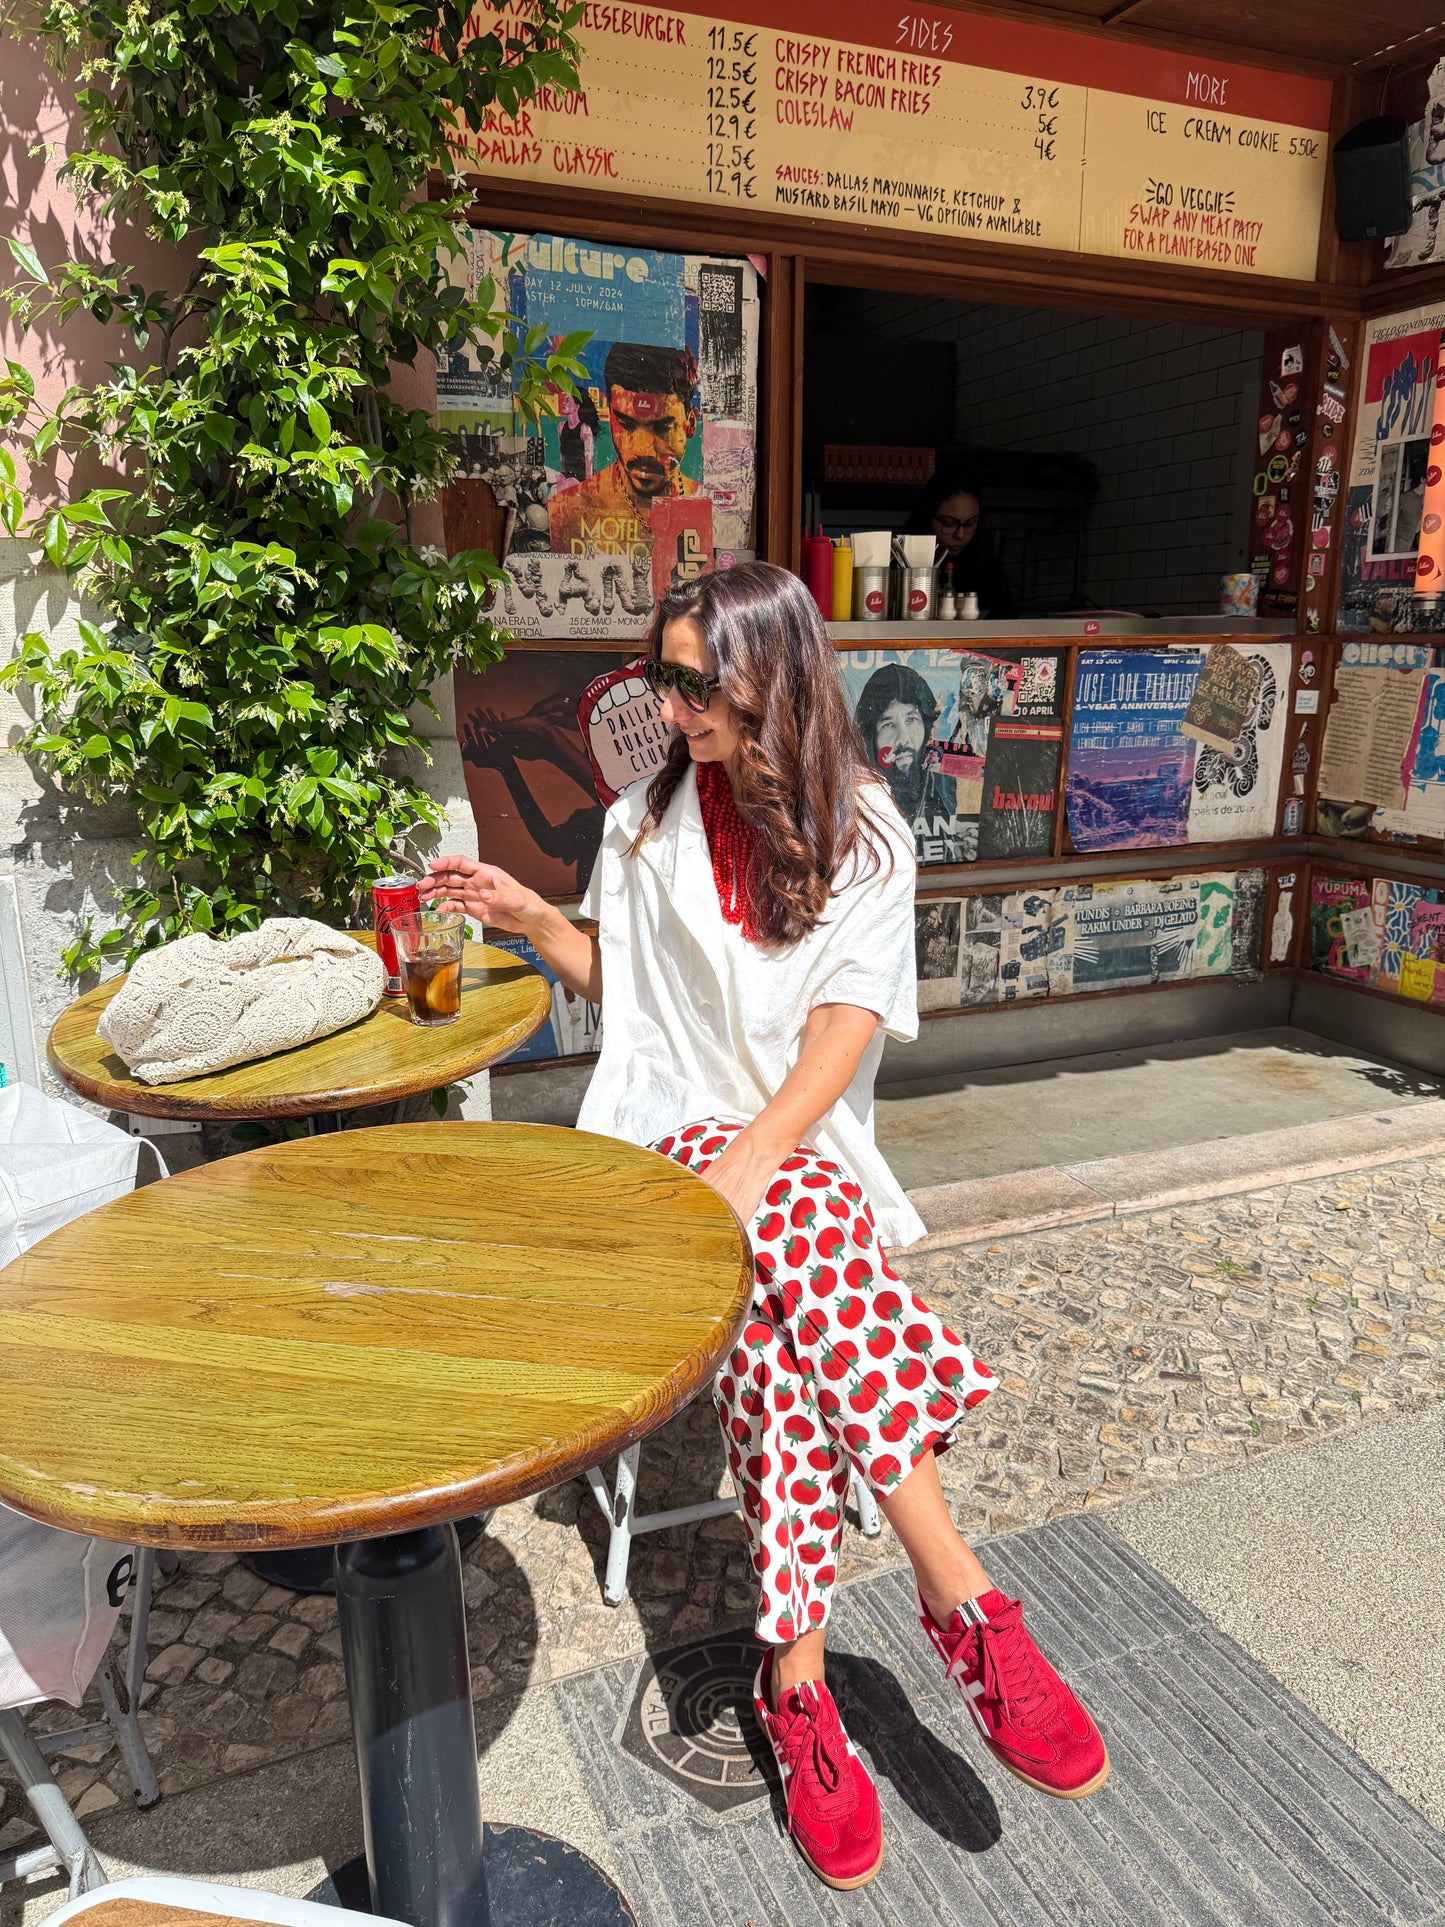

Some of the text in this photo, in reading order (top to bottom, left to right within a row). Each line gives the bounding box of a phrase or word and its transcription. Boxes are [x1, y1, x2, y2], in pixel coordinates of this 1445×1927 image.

[564, 1, 687, 46] EESEBURGER
[895, 15, 954, 53] SIDES
[706, 56, 758, 86] 12.5€
[775, 38, 942, 88] CRISPY FRENCH FRIES
[706, 86, 757, 115] 12.5€
[775, 67, 931, 116] CRISPY BACON FRIES
[1020, 86, 1060, 111] 3.9€
[1184, 71, 1230, 106] MORE
[465, 107, 534, 139] RGER
[775, 98, 854, 133] COLESLAW
[1038, 114, 1058, 136] 5€
[1146, 109, 1168, 134] ICE
[1183, 117, 1232, 146] CREAM
[1238, 129, 1279, 153] COOKIE
[476, 136, 543, 166] DALLAS
[552, 145, 619, 179] CLASSIC
[706, 142, 757, 172] 12.5€
[1034, 137, 1057, 161] 4€
[775, 164, 825, 186] SAUCES:
[952, 190, 1006, 212] KETCHUP
[1155, 182, 1224, 214] GO VEGGIE
[833, 192, 868, 214] BASIL
[870, 199, 900, 219] MAYO
[917, 204, 934, 223] VG
[937, 206, 983, 230] OPTIONS
[985, 212, 1042, 238] AVAILABLE
[1129, 203, 1263, 242] SWAP ANY MEAT PATTY
[1122, 228, 1144, 250] FOR
[1146, 234, 1156, 252] A
[1234, 246, 1256, 268] ONE
[549, 280, 563, 292] 12
[598, 286, 624, 300] 2024
[575, 297, 625, 313] 10PM/6AM
[579, 516, 641, 542] MOTEL
[508, 616, 527, 627] ERA
[1075, 673, 1105, 703] JUST
[1110, 673, 1140, 703] LOOK
[606, 697, 662, 736] DALLAS
[1029, 705, 1055, 717] APRIL
[1120, 702, 1190, 712] ANNIVERSAR
[613, 720, 671, 757] BURGER
[629, 746, 668, 773] CLUB
[1081, 920, 1111, 934] RAKIM
[1111, 917, 1143, 931] UNDER
